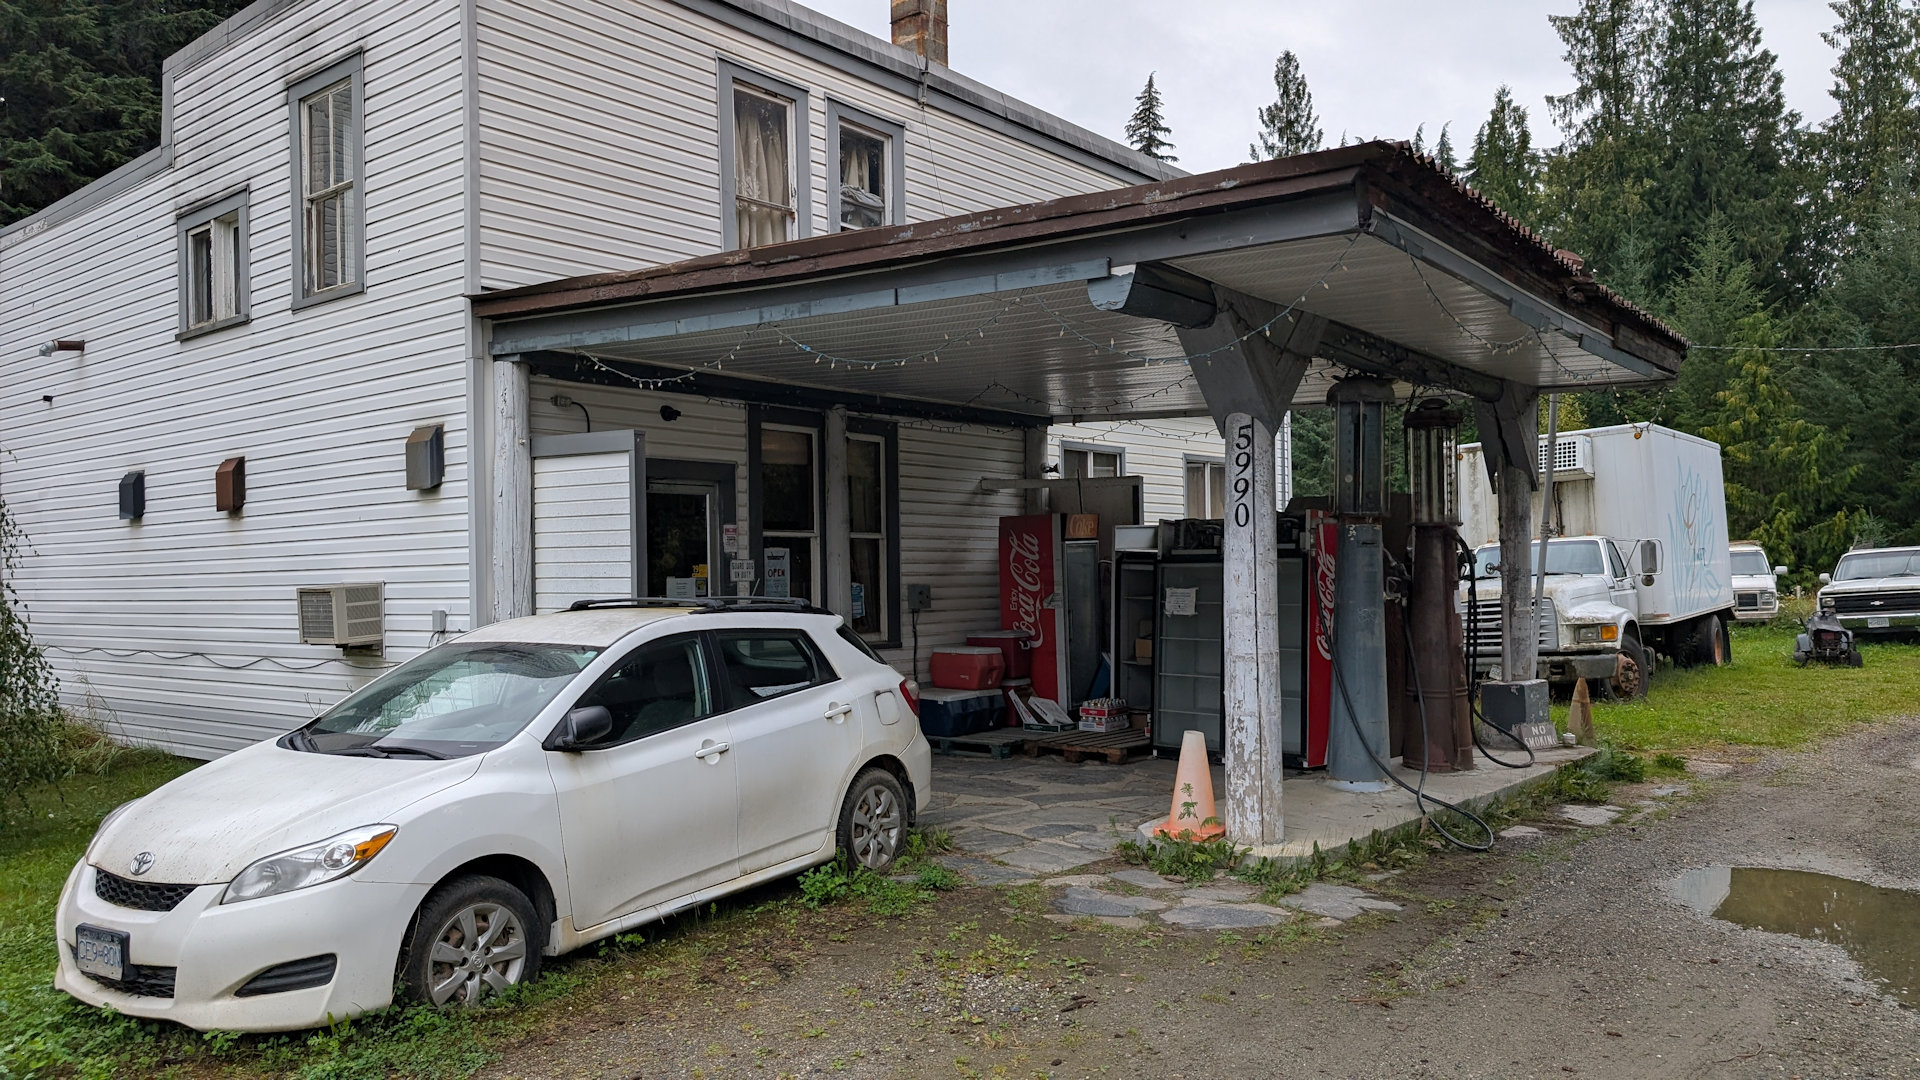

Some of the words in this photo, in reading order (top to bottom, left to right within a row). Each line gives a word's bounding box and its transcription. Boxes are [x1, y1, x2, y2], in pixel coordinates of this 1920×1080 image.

[1234, 424, 1252, 527] 5990
[1069, 514, 1095, 537] Coke
[767, 568, 786, 578] OPEN
[1009, 588, 1018, 611] Enjoy
[1531, 725, 1546, 736] NO
